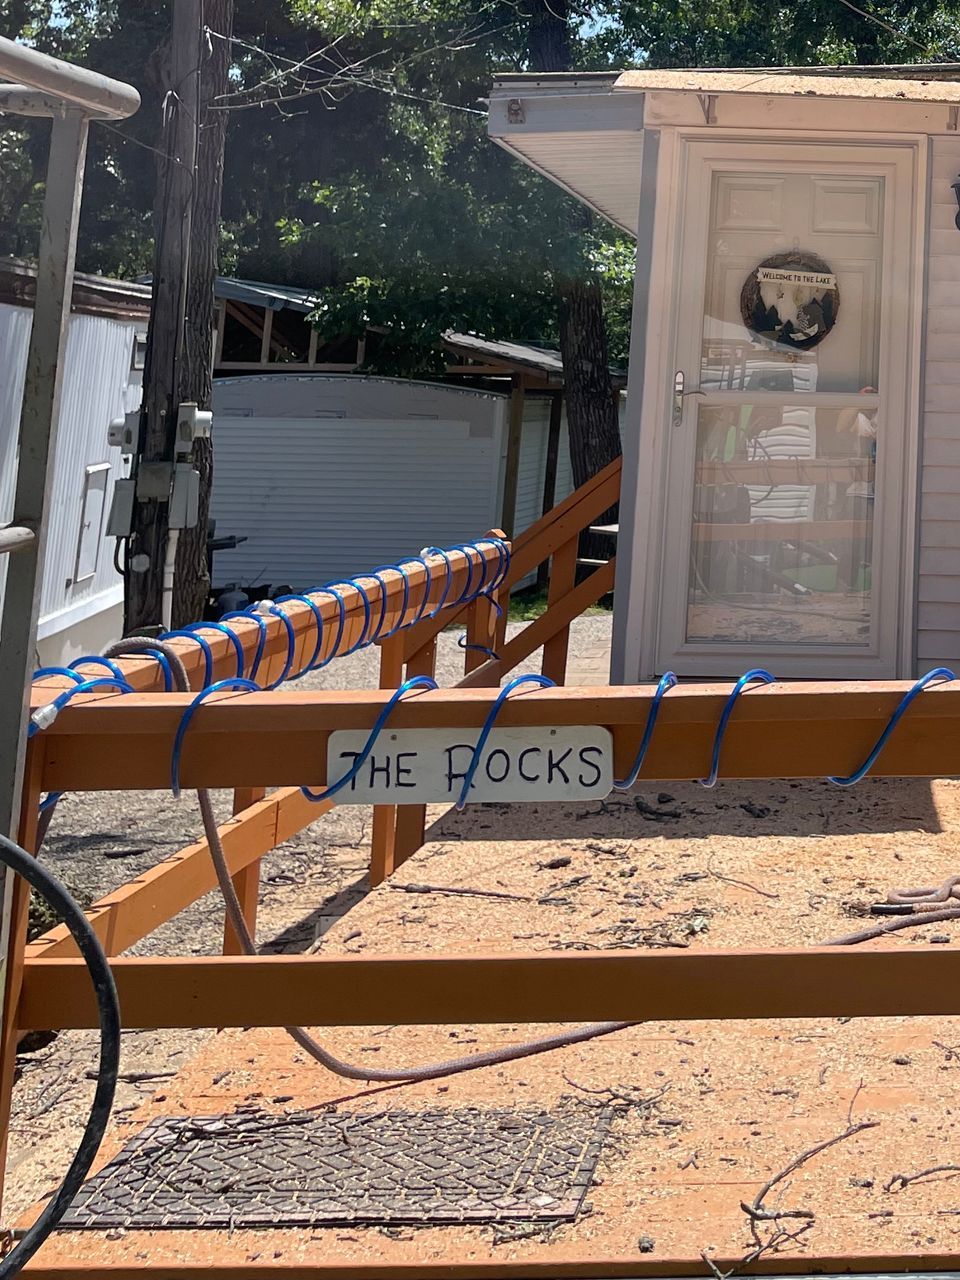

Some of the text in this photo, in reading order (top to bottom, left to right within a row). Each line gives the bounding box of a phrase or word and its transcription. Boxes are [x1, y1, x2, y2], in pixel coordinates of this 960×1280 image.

[762, 271, 793, 282] WELCOME
[803, 275, 815, 283] THE
[816, 276, 831, 285] LAKE
[339, 744, 603, 793] THE ROCKS
